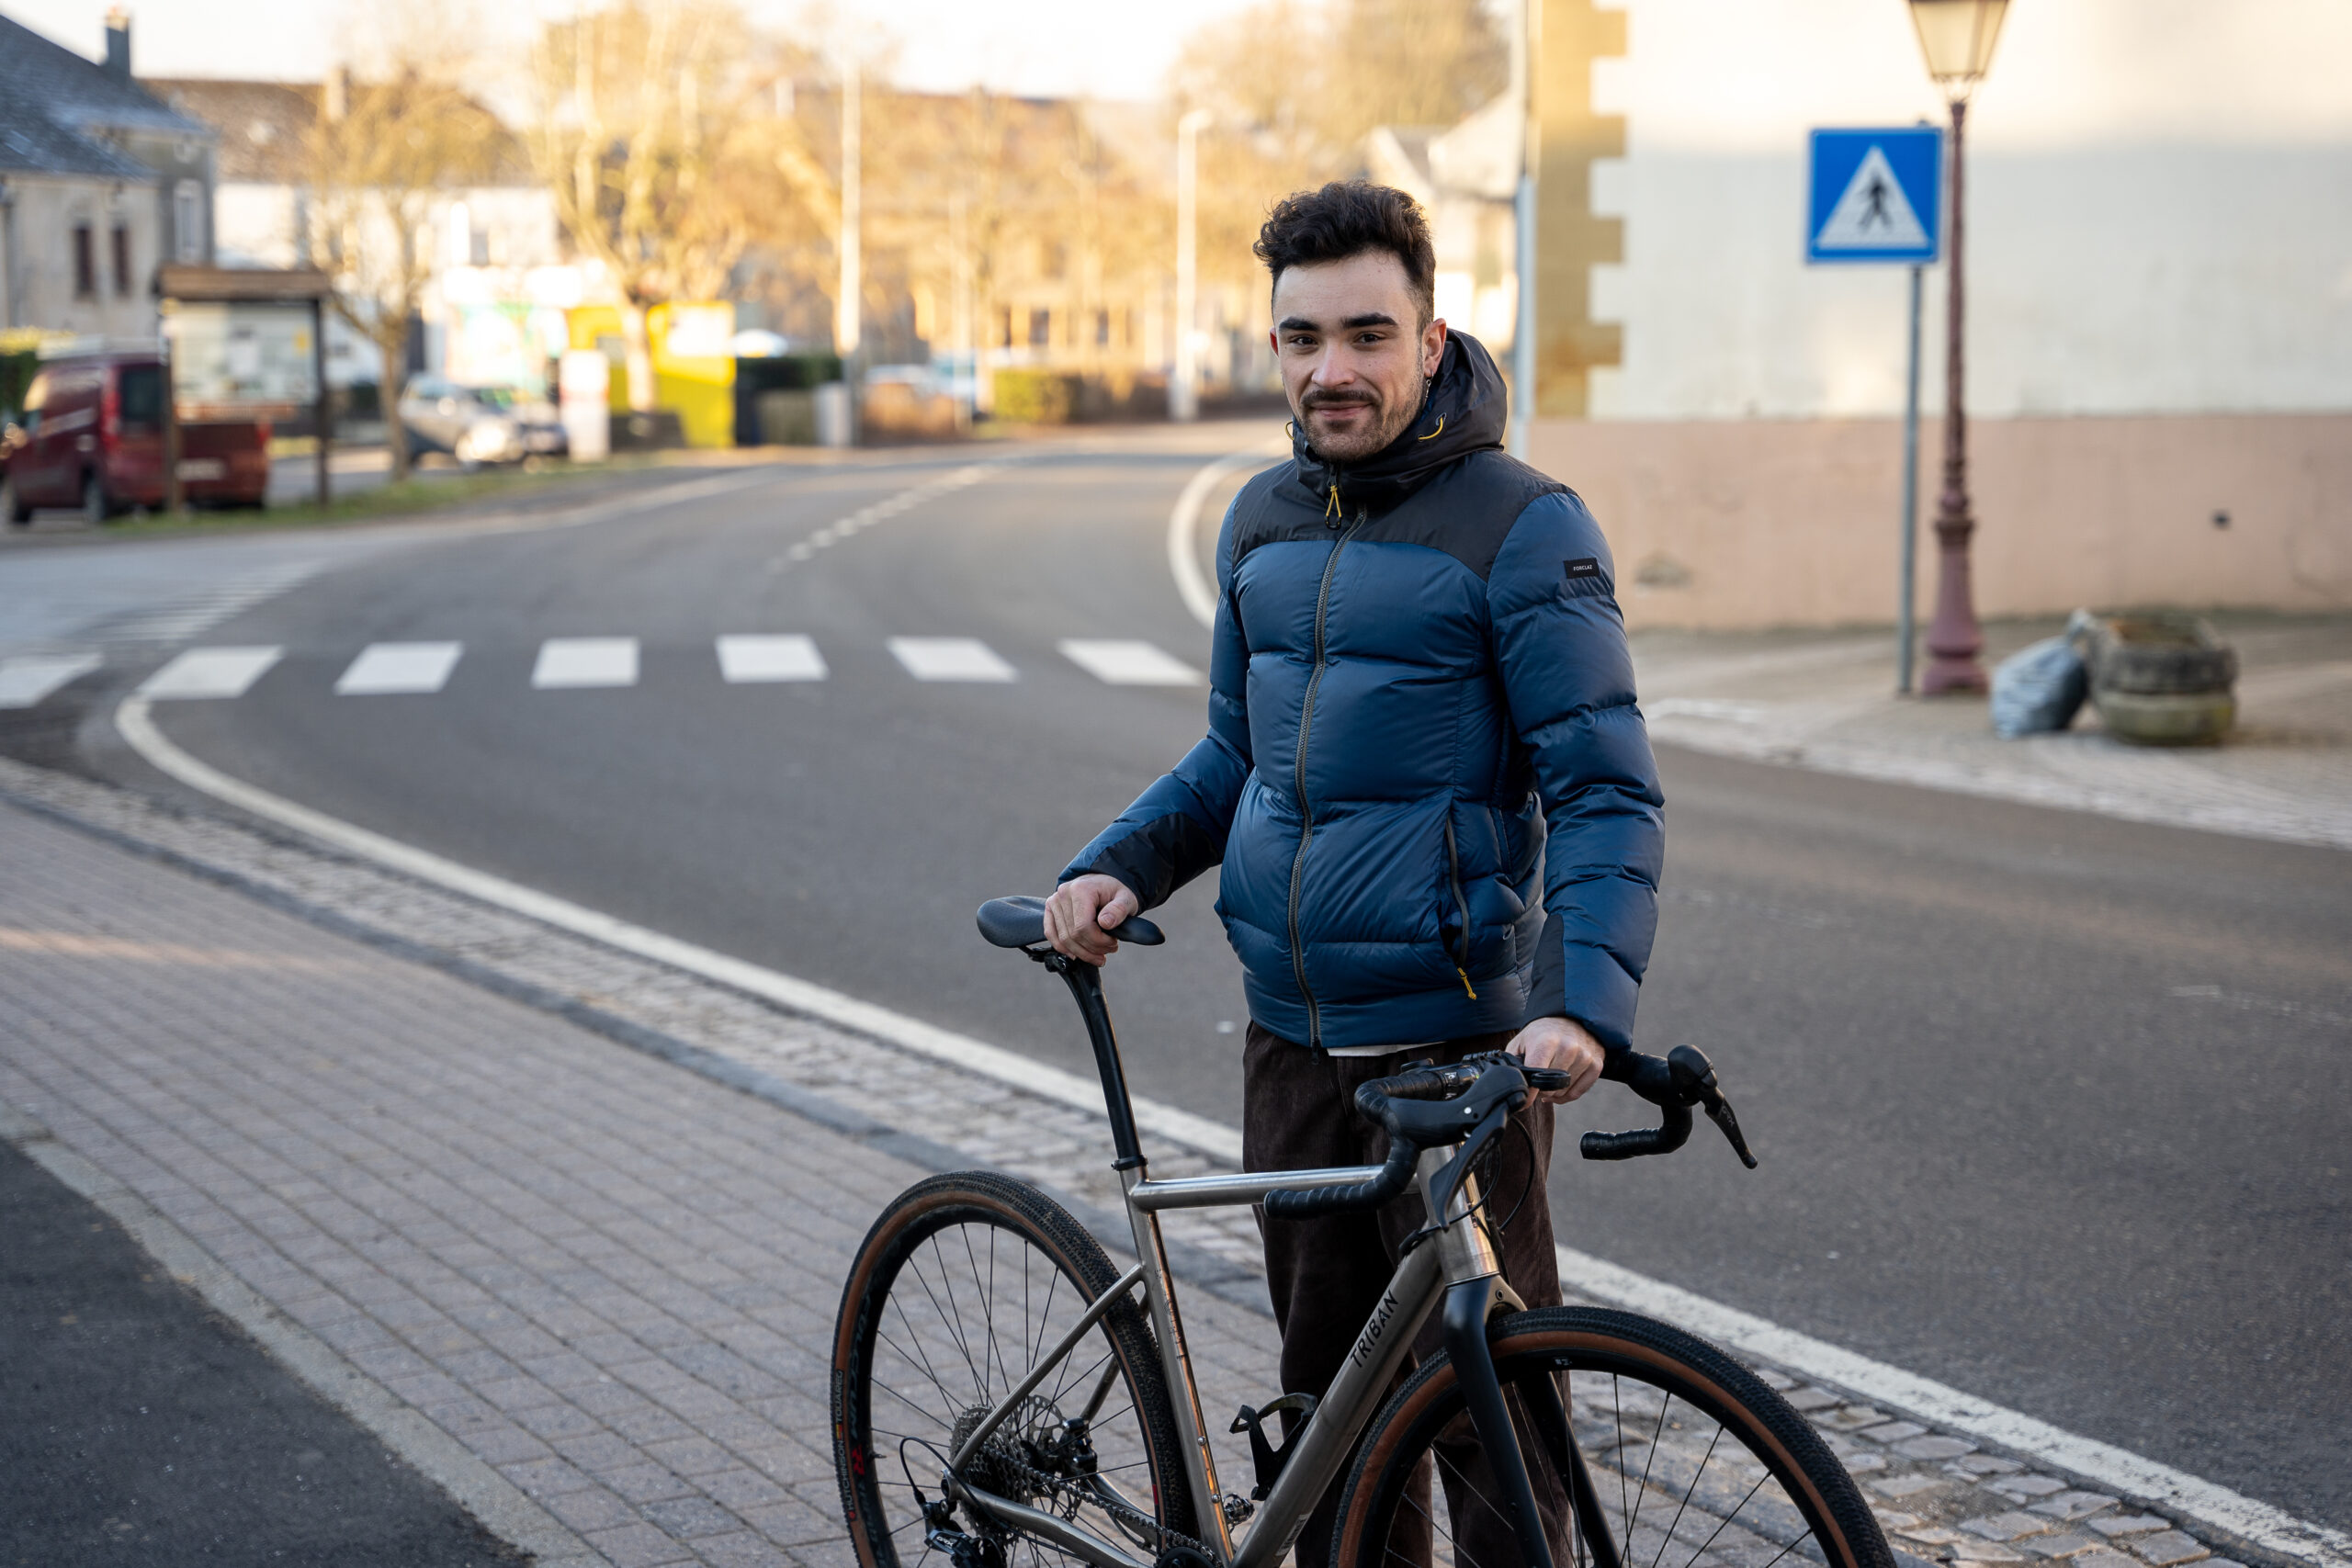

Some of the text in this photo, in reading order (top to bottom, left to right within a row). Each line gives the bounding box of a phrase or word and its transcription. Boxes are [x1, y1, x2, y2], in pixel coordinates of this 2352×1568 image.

[1350, 1289, 1399, 1368] TRIBAN
[834, 1370, 854, 1511] HUTCHINSON TOUAREG
[935, 1536, 955, 1548] GRX
